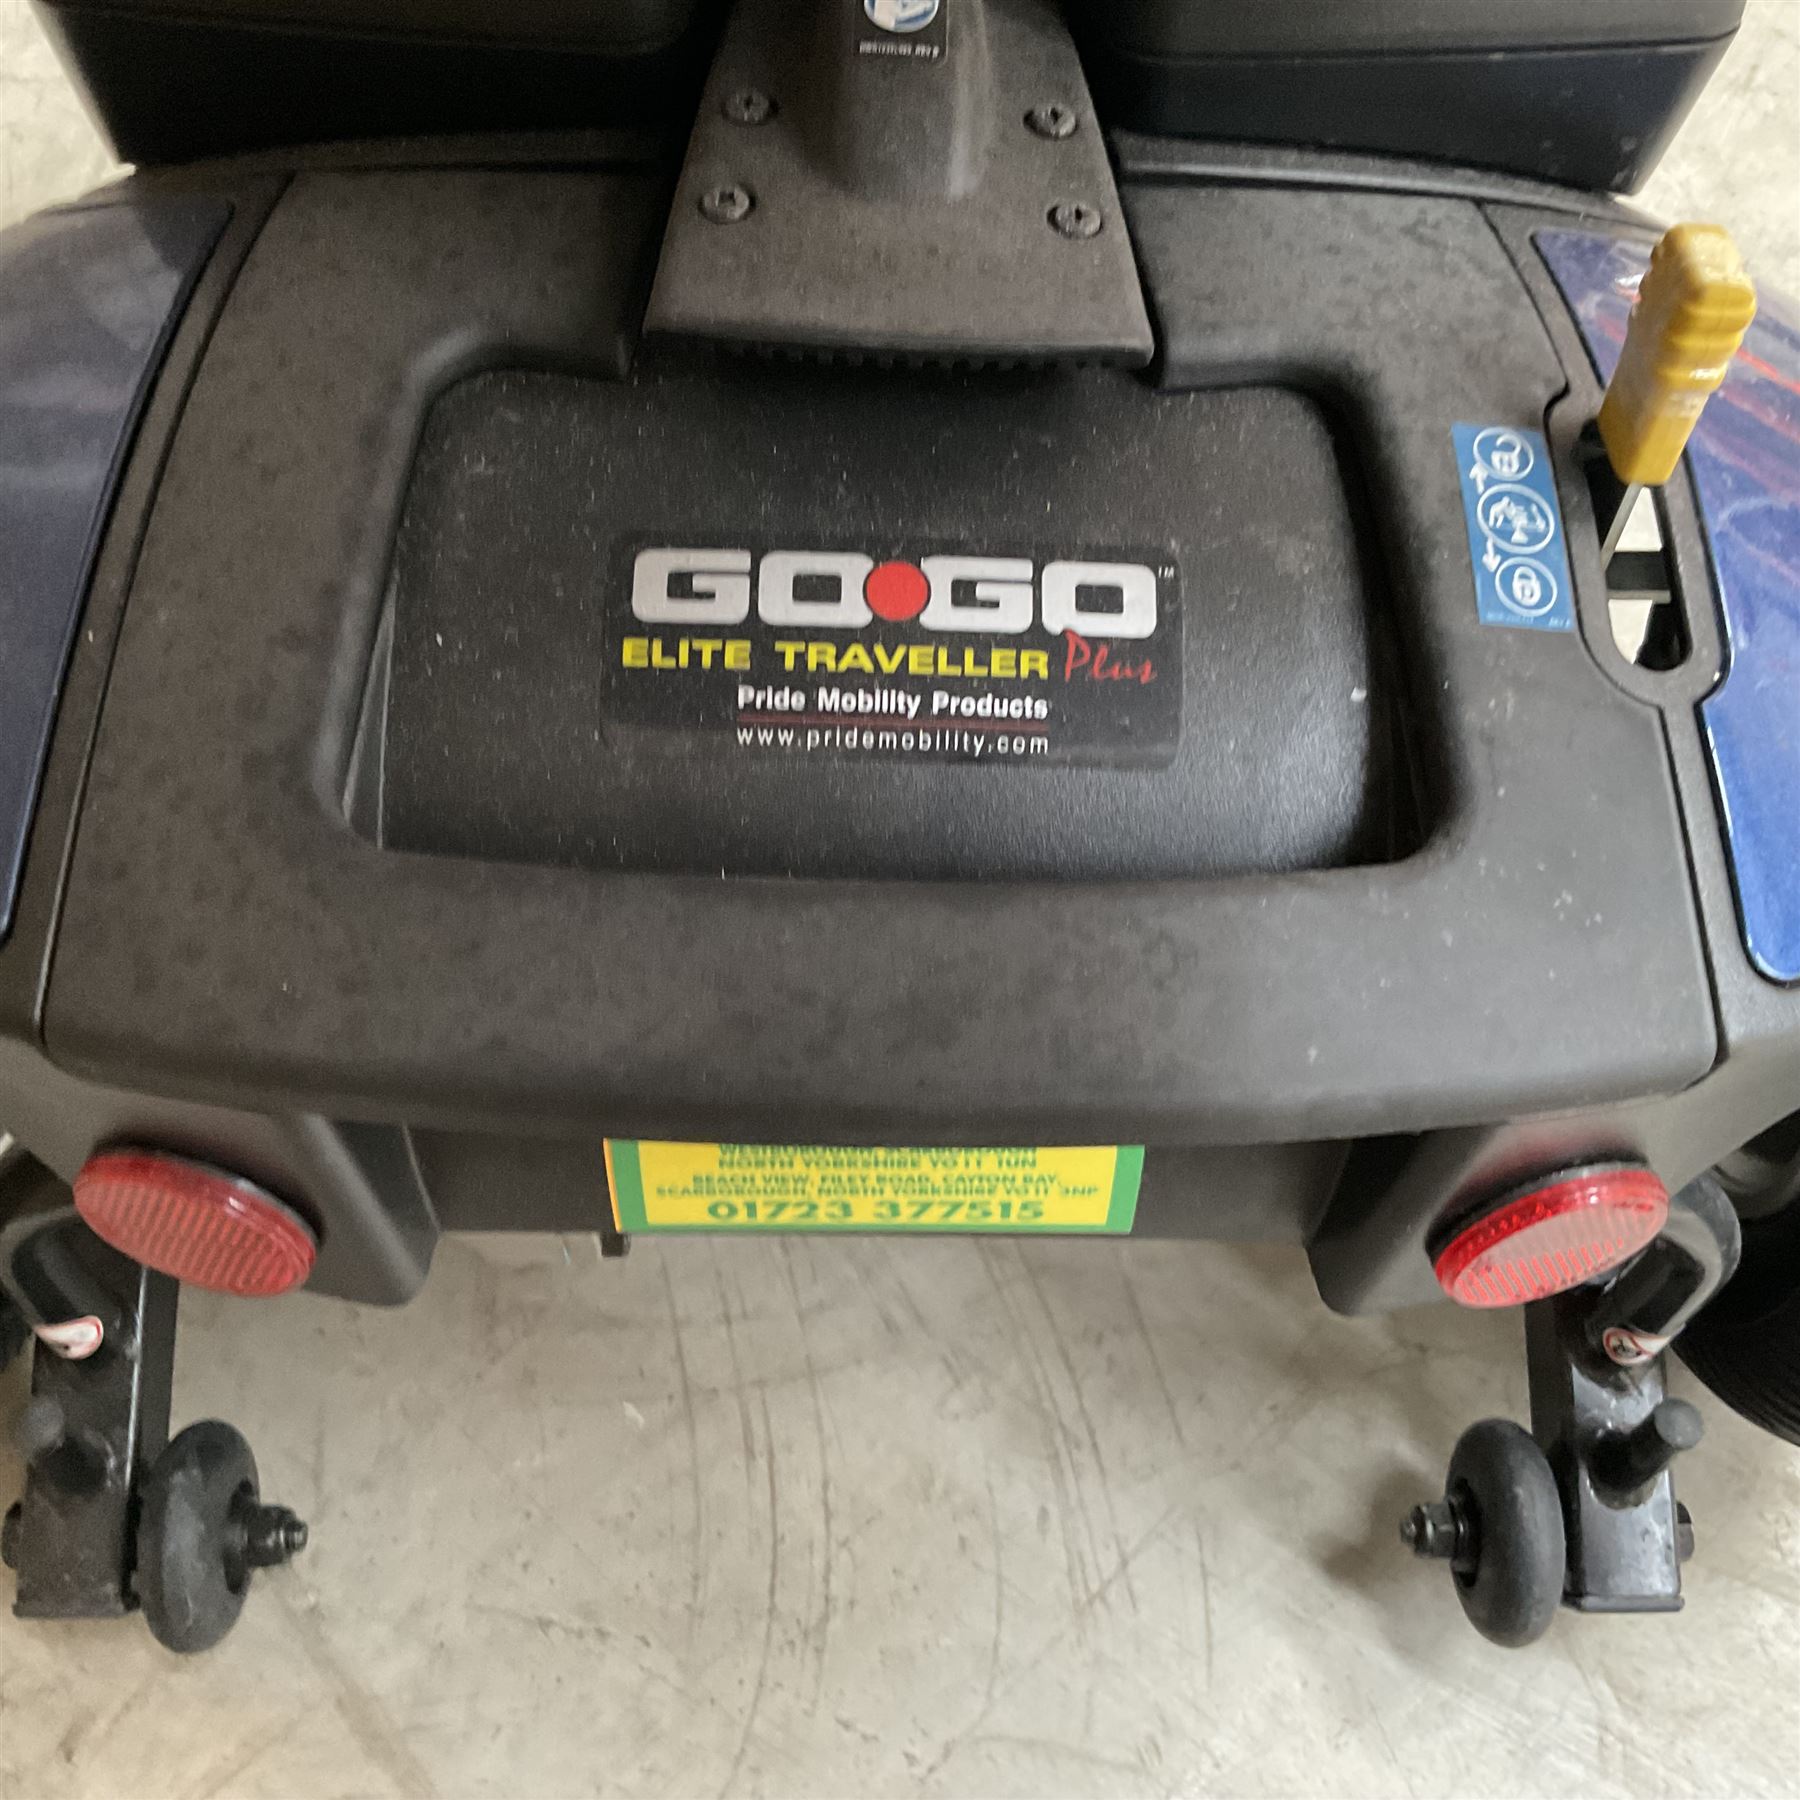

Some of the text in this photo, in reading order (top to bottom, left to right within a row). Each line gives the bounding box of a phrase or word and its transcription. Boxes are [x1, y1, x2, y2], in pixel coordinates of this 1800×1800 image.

[623, 628, 1159, 684] ELITE TRAVELLER Plus
[737, 684, 1048, 720] Pride Mobility Products
[737, 727, 1049, 757] www.pridemobility.com
[718, 1156, 794, 1169] NORTH
[802, 1157, 920, 1169] YORKSHIRE
[692, 1174, 755, 1185] BEACH
[817, 1185, 885, 1196] NORTH
[890, 1185, 997, 1196] YORKSHIRE
[707, 1200, 1044, 1220] 01723 377515
